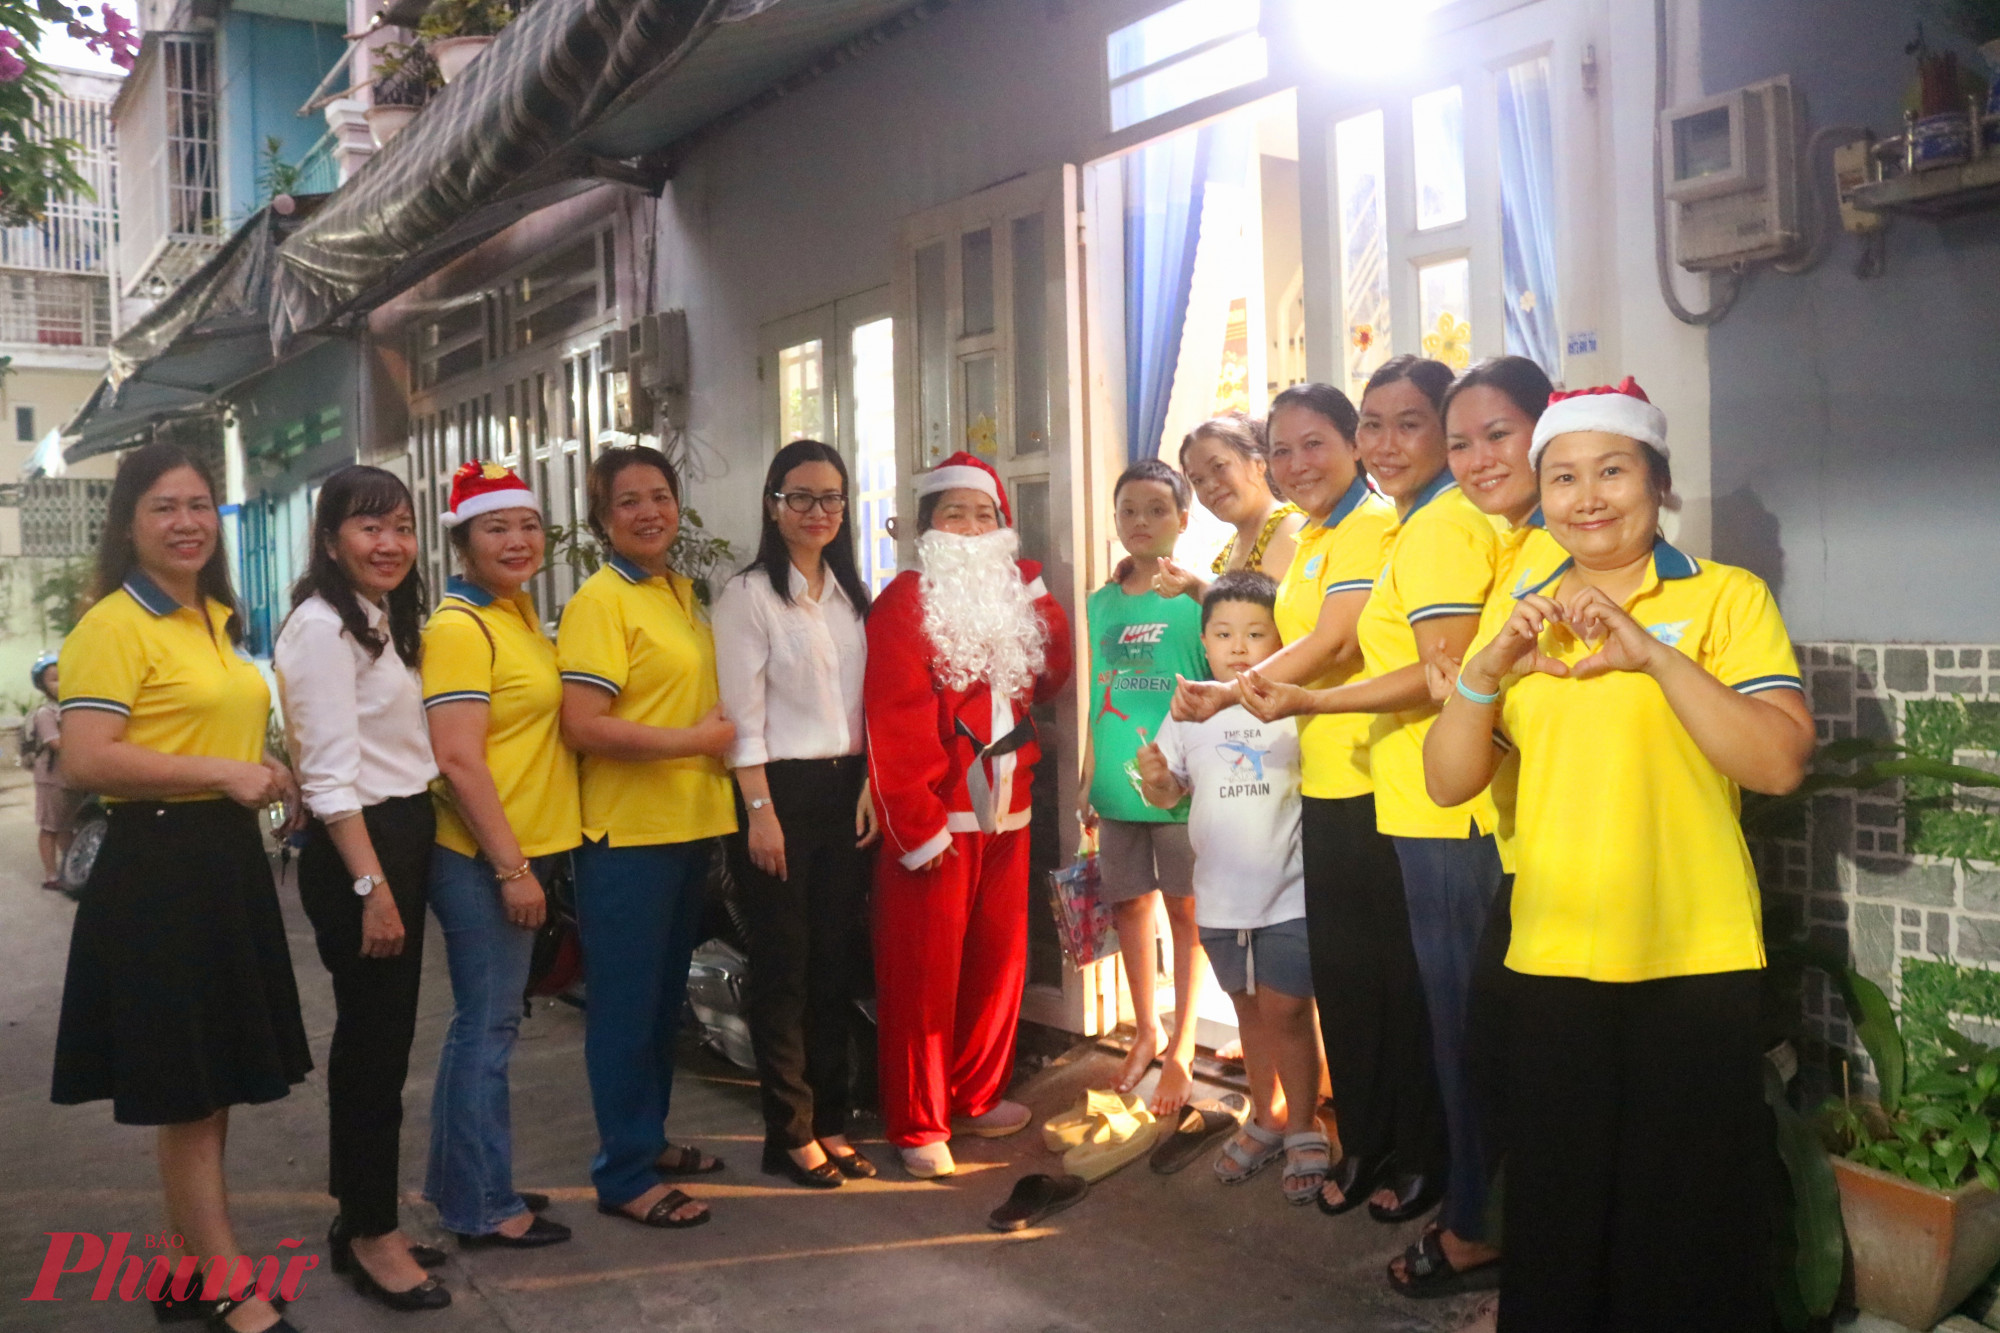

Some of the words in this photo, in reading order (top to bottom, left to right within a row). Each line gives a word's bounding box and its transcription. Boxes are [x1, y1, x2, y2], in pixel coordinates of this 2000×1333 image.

[1118, 623, 1169, 645] NIKE
[1114, 677, 1172, 691] JORDEN
[1244, 729, 1262, 738] SEA
[1219, 782, 1270, 799] CAPTAIN
